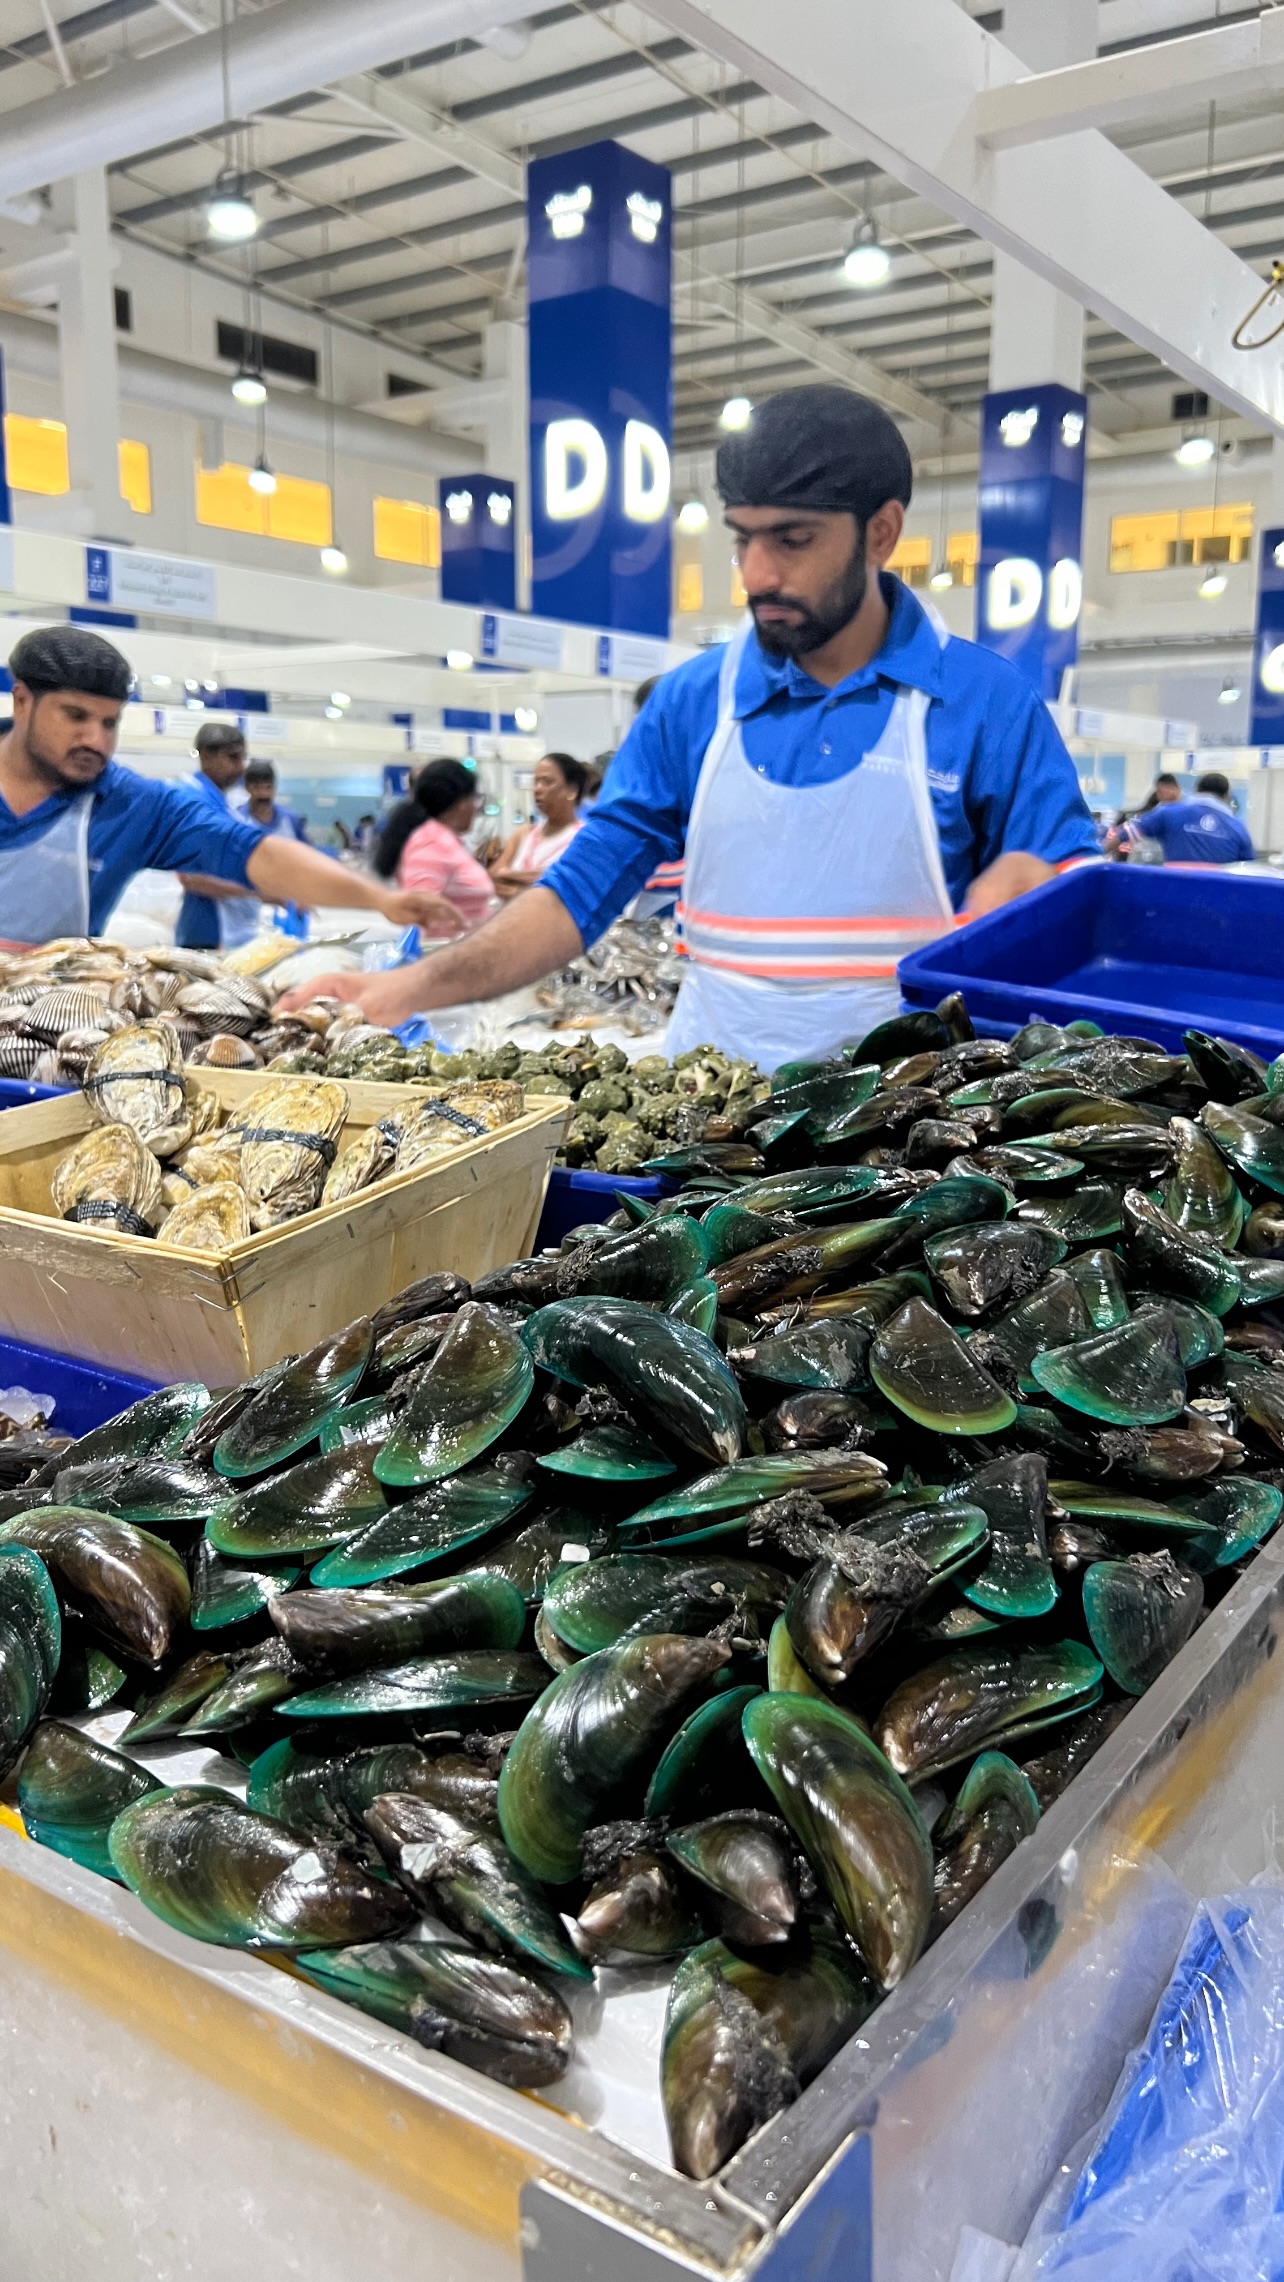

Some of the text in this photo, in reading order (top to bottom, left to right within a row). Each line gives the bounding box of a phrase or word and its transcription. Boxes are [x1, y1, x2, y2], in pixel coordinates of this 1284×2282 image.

[545, 419, 607, 519] D
[624, 419, 670, 521] D
[988, 558, 1042, 629] D
